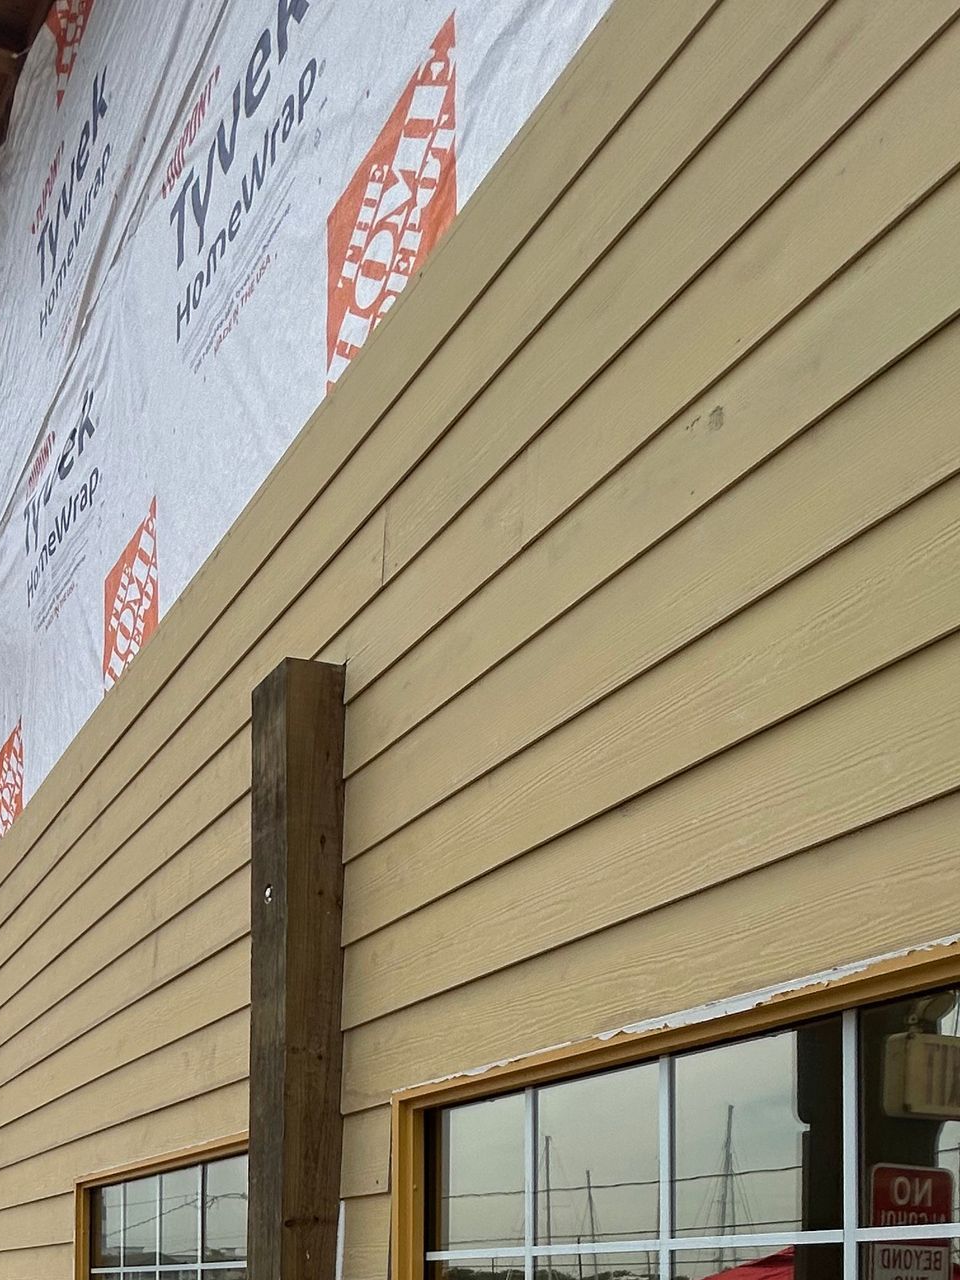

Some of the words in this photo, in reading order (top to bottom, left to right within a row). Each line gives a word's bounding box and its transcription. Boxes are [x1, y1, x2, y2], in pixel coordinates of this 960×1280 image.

[37, 66, 108, 288] Tyvek
[40, 143, 111, 339] HomeWrap
[176, 58, 317, 344] HomeWrap
[327, 47, 456, 384] HOME
[26, 467, 99, 608] HomeWrap
